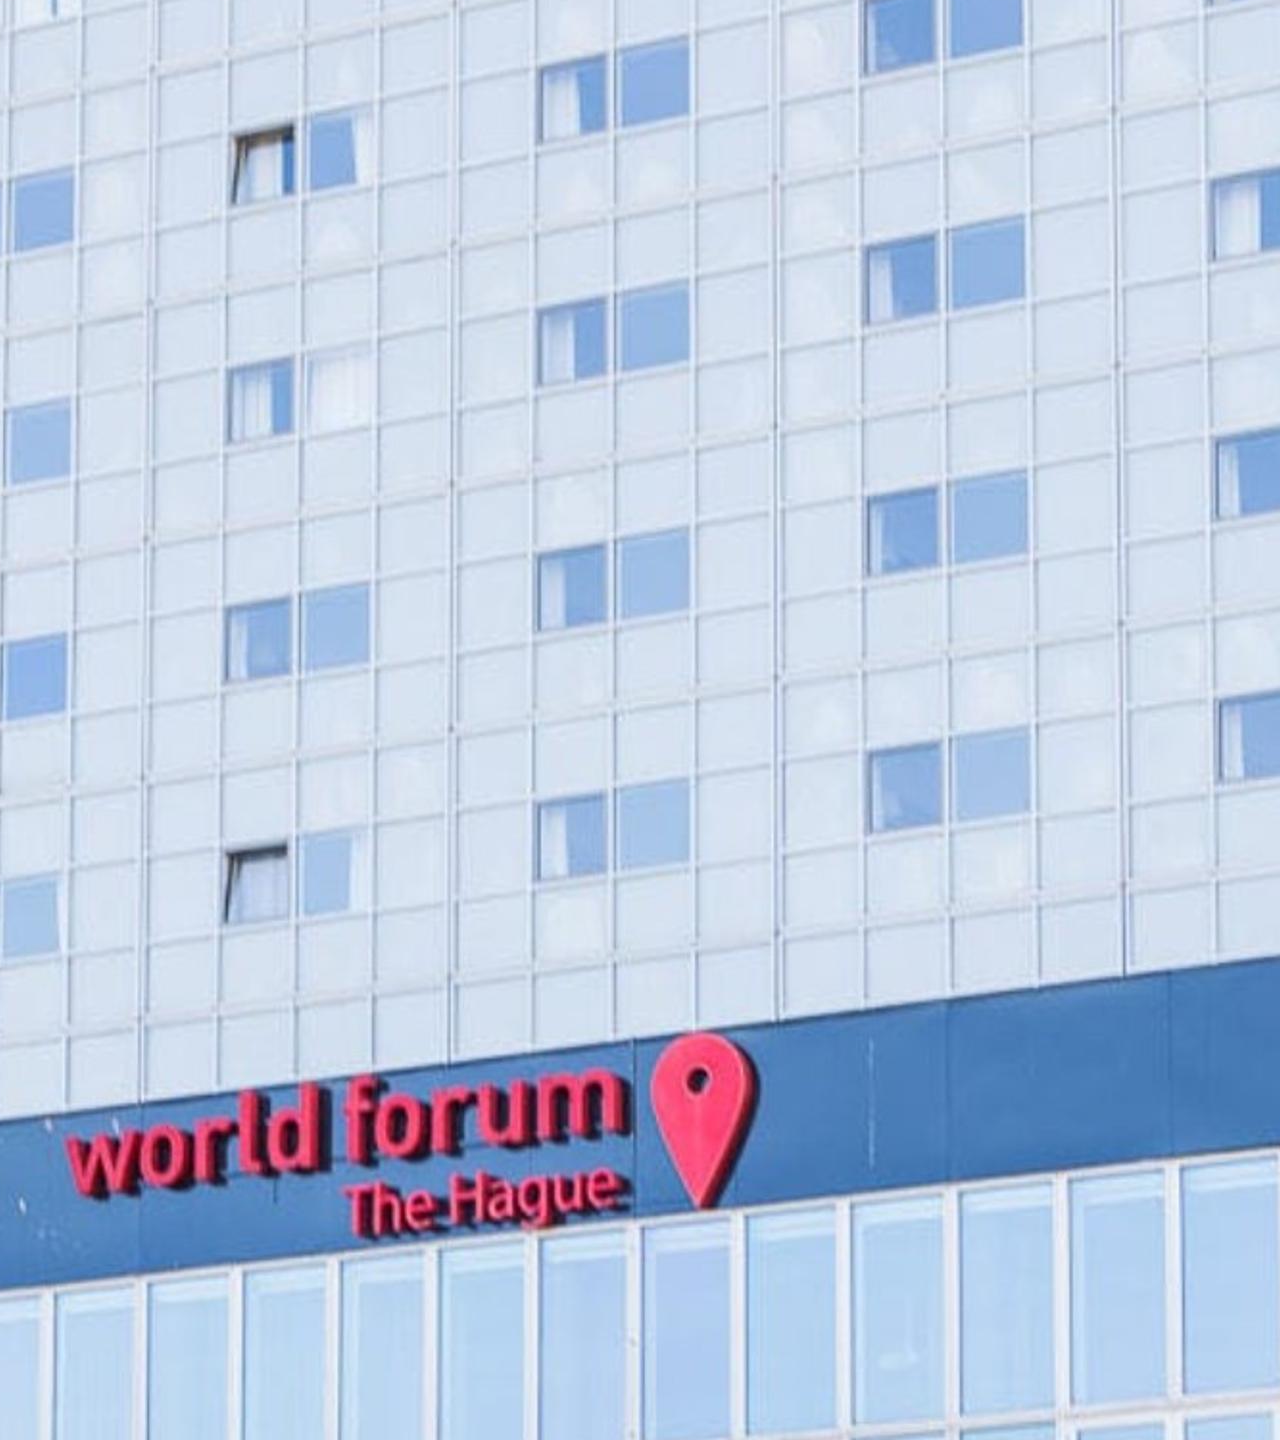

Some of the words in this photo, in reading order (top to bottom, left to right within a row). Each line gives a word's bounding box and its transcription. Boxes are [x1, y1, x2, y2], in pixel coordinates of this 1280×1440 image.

[65, 1080, 325, 1197] world
[343, 1066, 630, 1164] forum
[342, 1178, 434, 1238] The
[447, 1166, 620, 1229] Hague
